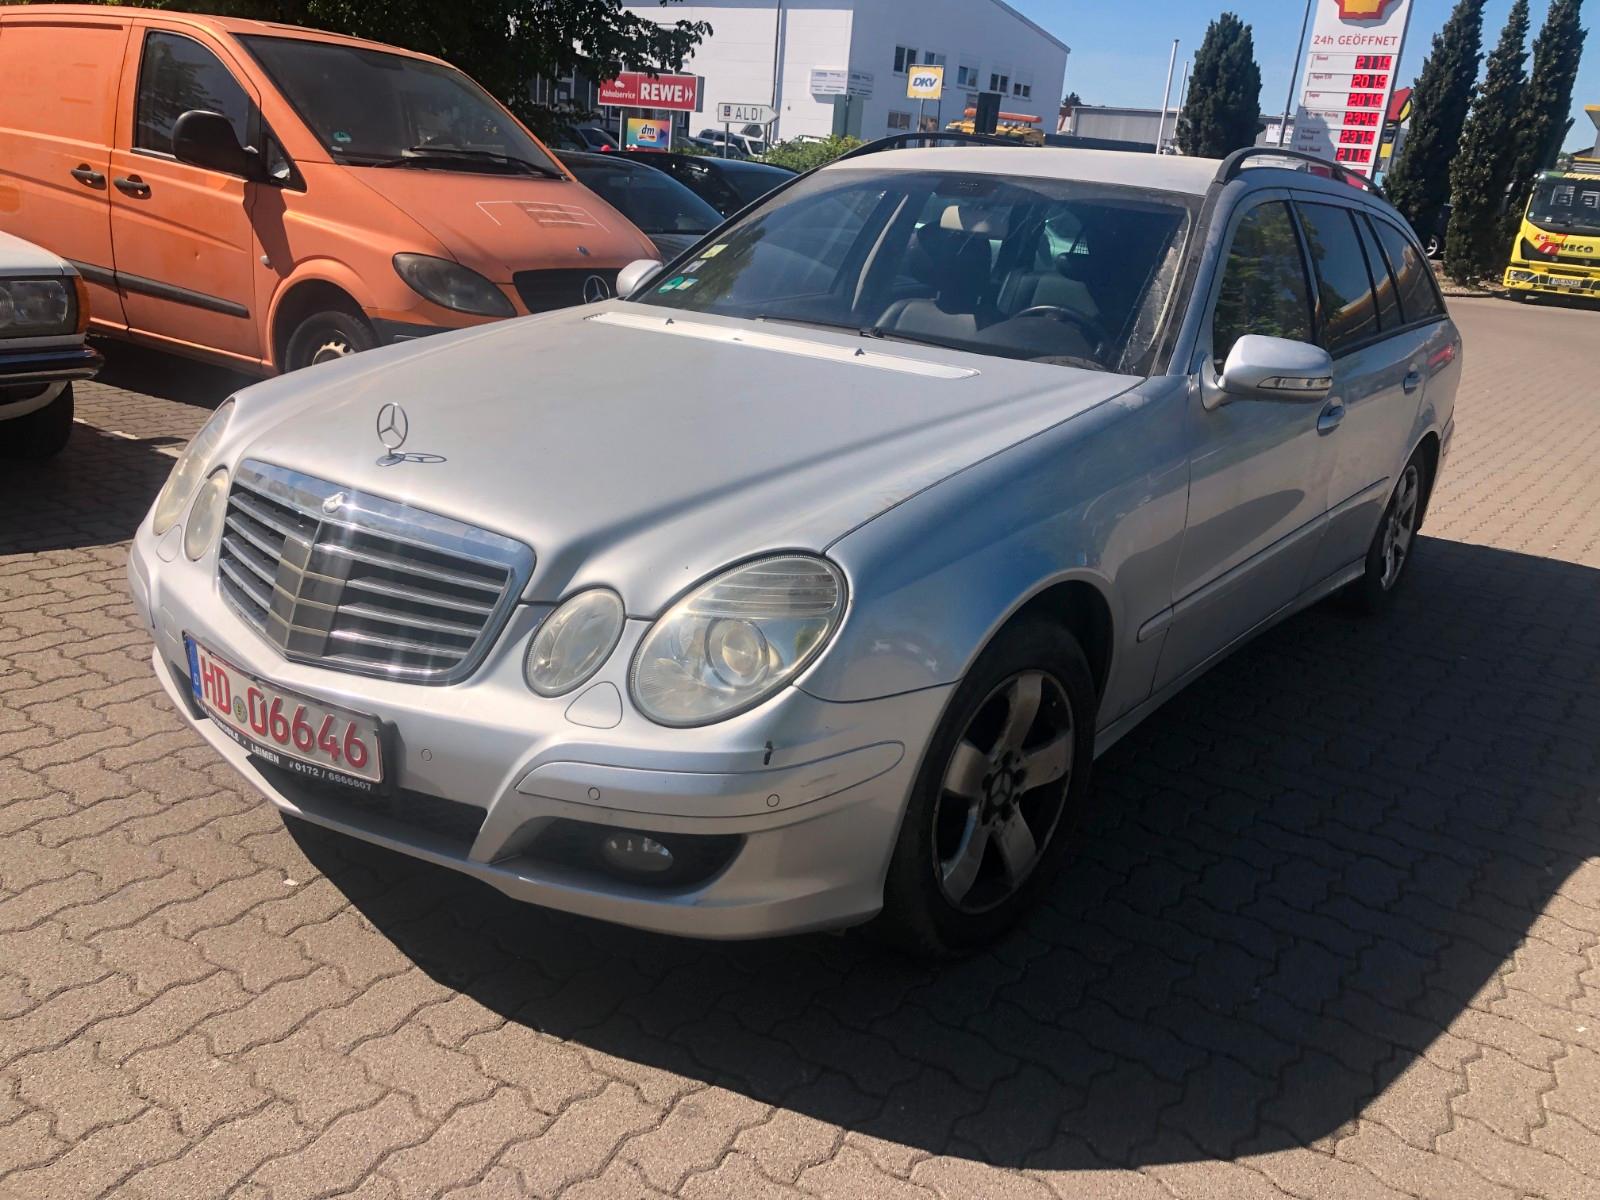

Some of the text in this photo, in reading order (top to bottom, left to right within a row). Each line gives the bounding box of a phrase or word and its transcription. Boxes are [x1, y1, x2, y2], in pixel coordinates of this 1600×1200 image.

[1313, 33, 1399, 46] 24h GEÖFFNET
[912, 76, 938, 88] DKV
[640, 82, 683, 102] REWE
[735, 106, 762, 121] ALDI
[641, 124, 655, 135] dm
[201, 654, 368, 769] HD 06646
[251, 743, 280, 764] LEIMEN
[295, 762, 319, 777] 0172
